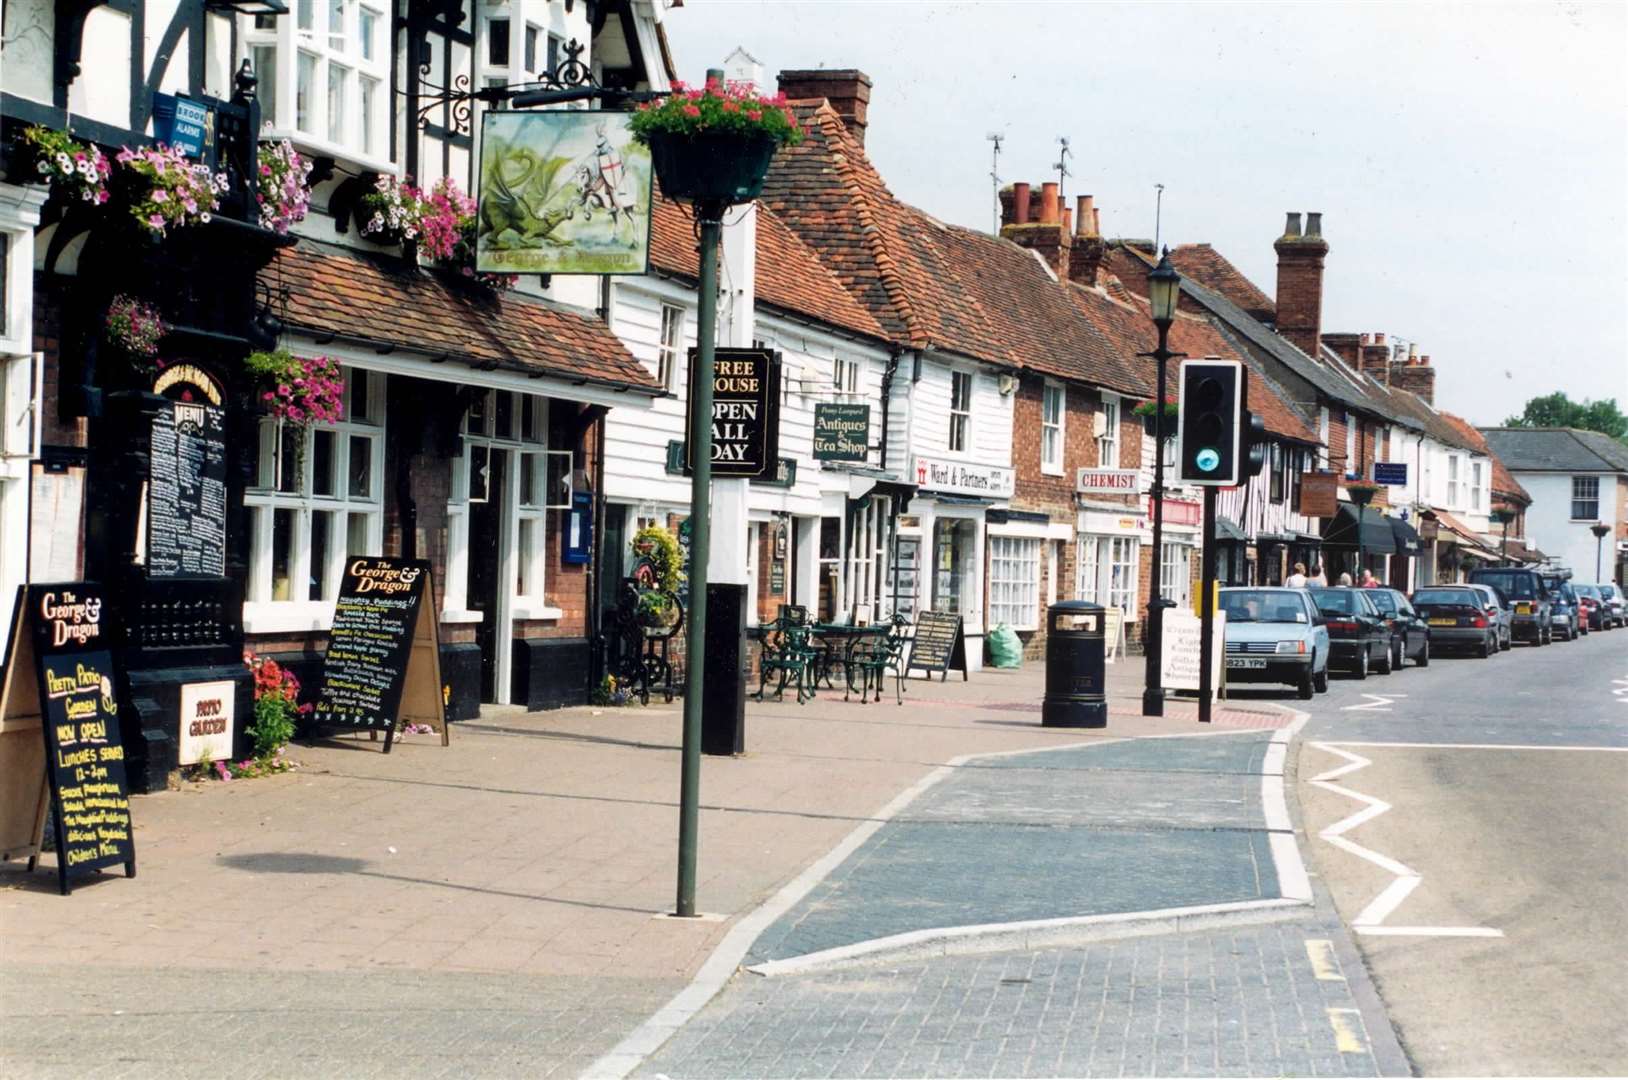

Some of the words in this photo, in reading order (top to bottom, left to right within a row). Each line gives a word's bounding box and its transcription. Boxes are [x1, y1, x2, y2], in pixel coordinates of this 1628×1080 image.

[713, 377, 760, 392] OUSE
[175, 405, 205, 428] MENU
[816, 416, 866, 433] Antiques
[711, 423, 749, 440] ALL
[838, 431, 845, 439] &
[710, 444, 749, 461] DAY
[815, 437, 836, 453] Tea
[837, 438, 867, 457] Shop
[930, 463, 949, 485] Ward
[951, 466, 957, 486] &
[960, 467, 988, 490] Partners
[1082, 473, 1137, 489] CHEMIST
[351, 560, 401, 583] George
[399, 567, 421, 584] &
[377, 561, 392, 569] The
[355, 576, 412, 595] Dragon
[63, 591, 76, 604] The
[42, 592, 86, 624] George
[85, 597, 102, 624] &
[53, 619, 100, 647] Dragon
[57, 724, 75, 742] NOW
[81, 719, 106, 739] OPEN
